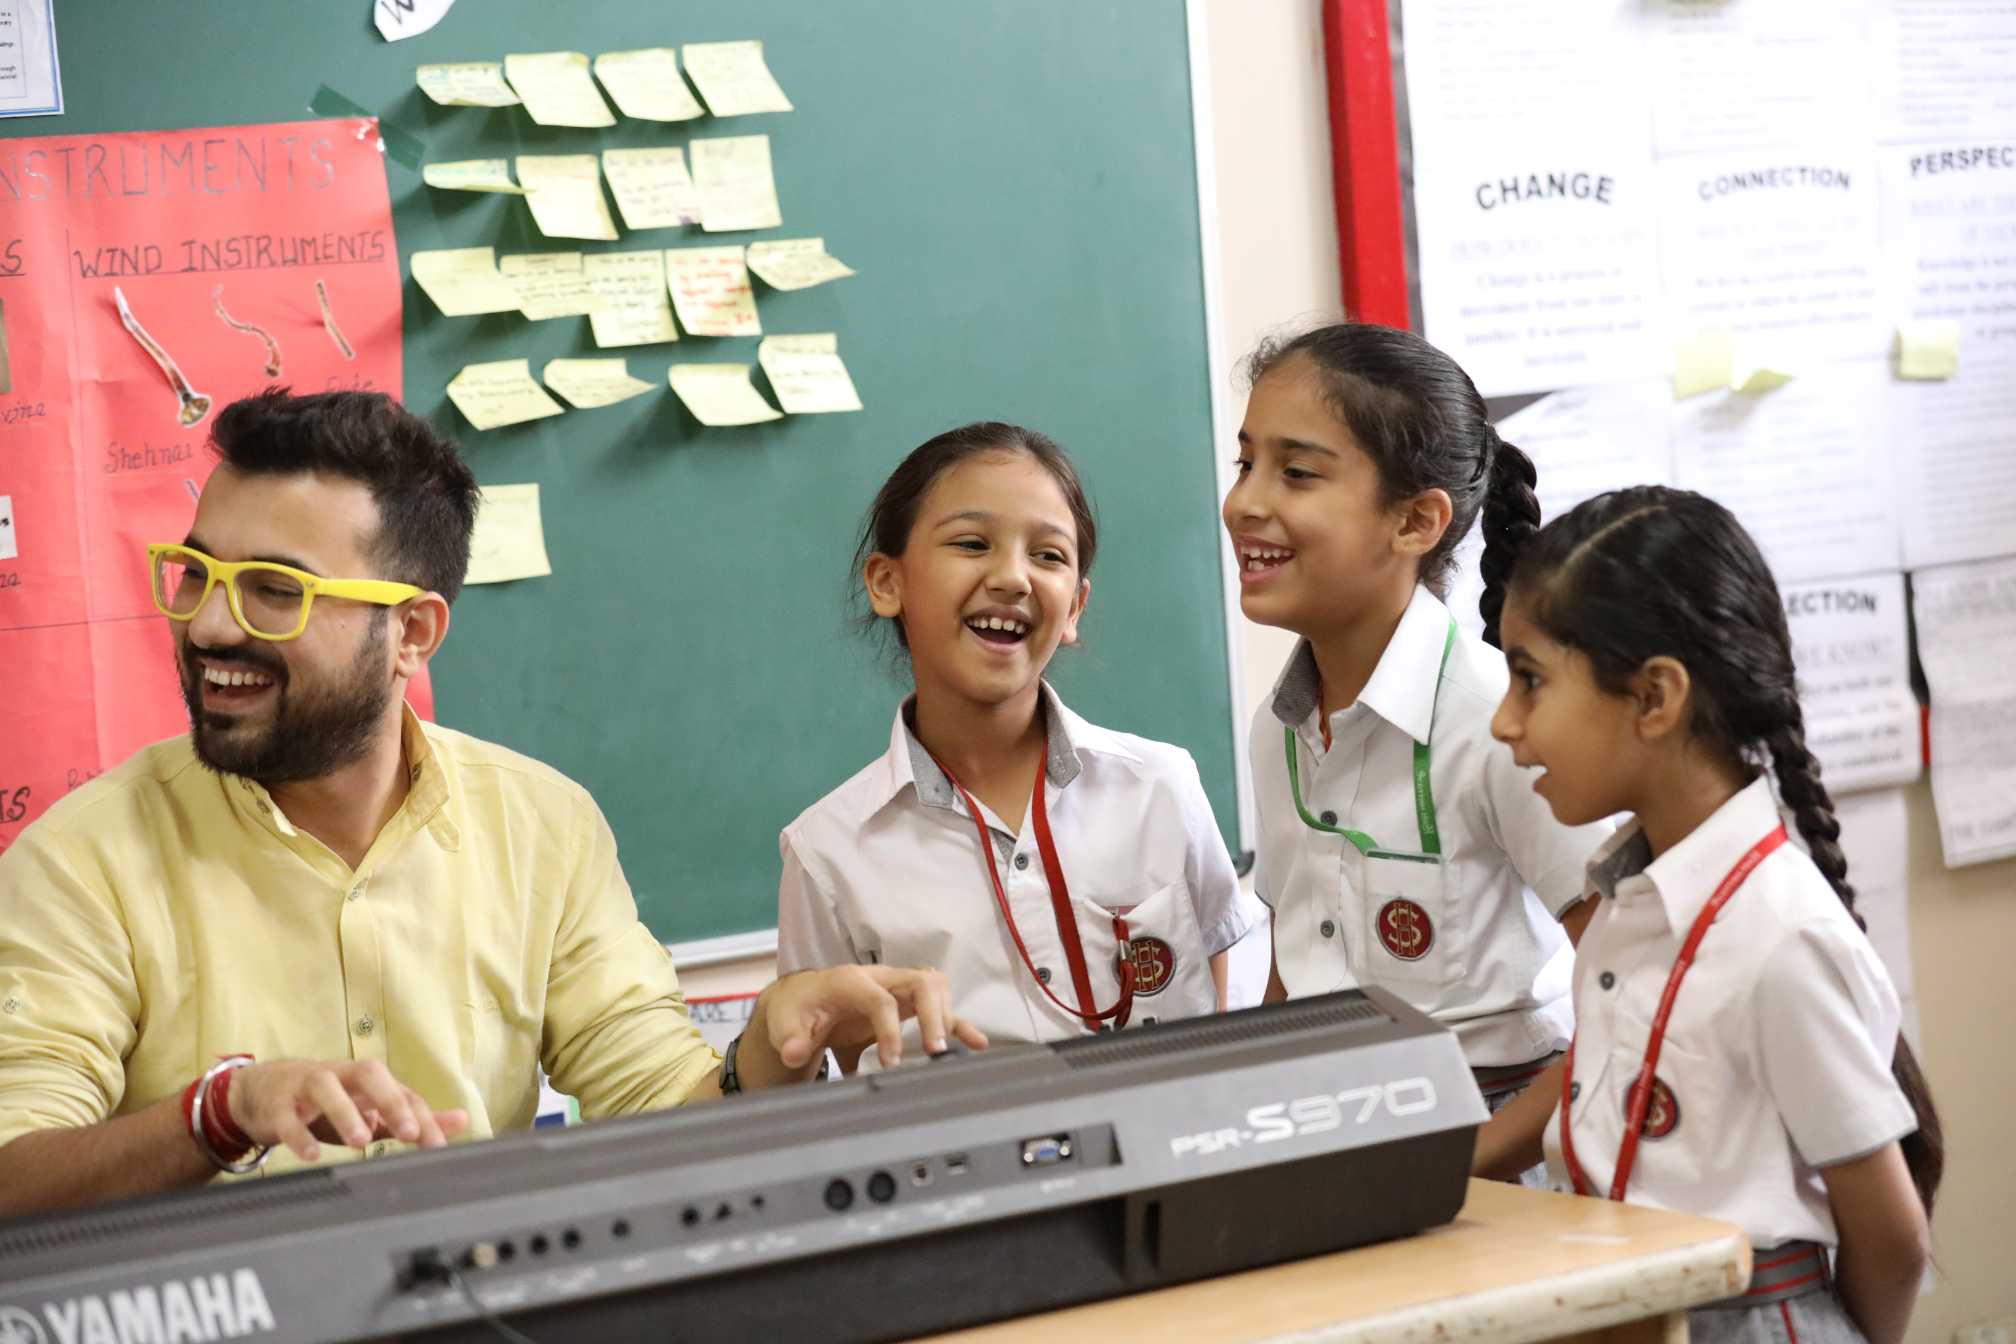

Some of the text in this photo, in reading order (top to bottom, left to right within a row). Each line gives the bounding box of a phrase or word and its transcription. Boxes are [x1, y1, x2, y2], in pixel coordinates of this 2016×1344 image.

[1908, 146, 2016, 178] PERSPEC
[1475, 170, 1615, 211] CHANGE
[1698, 165, 1850, 202] CONNECTION
[73, 230, 386, 278] WIND INSTRUMENTS
[1788, 590, 1877, 616] ECTION
[1170, 1076, 1437, 1159] PSR-S970
[42, 1267, 276, 1344] YAMAHA
